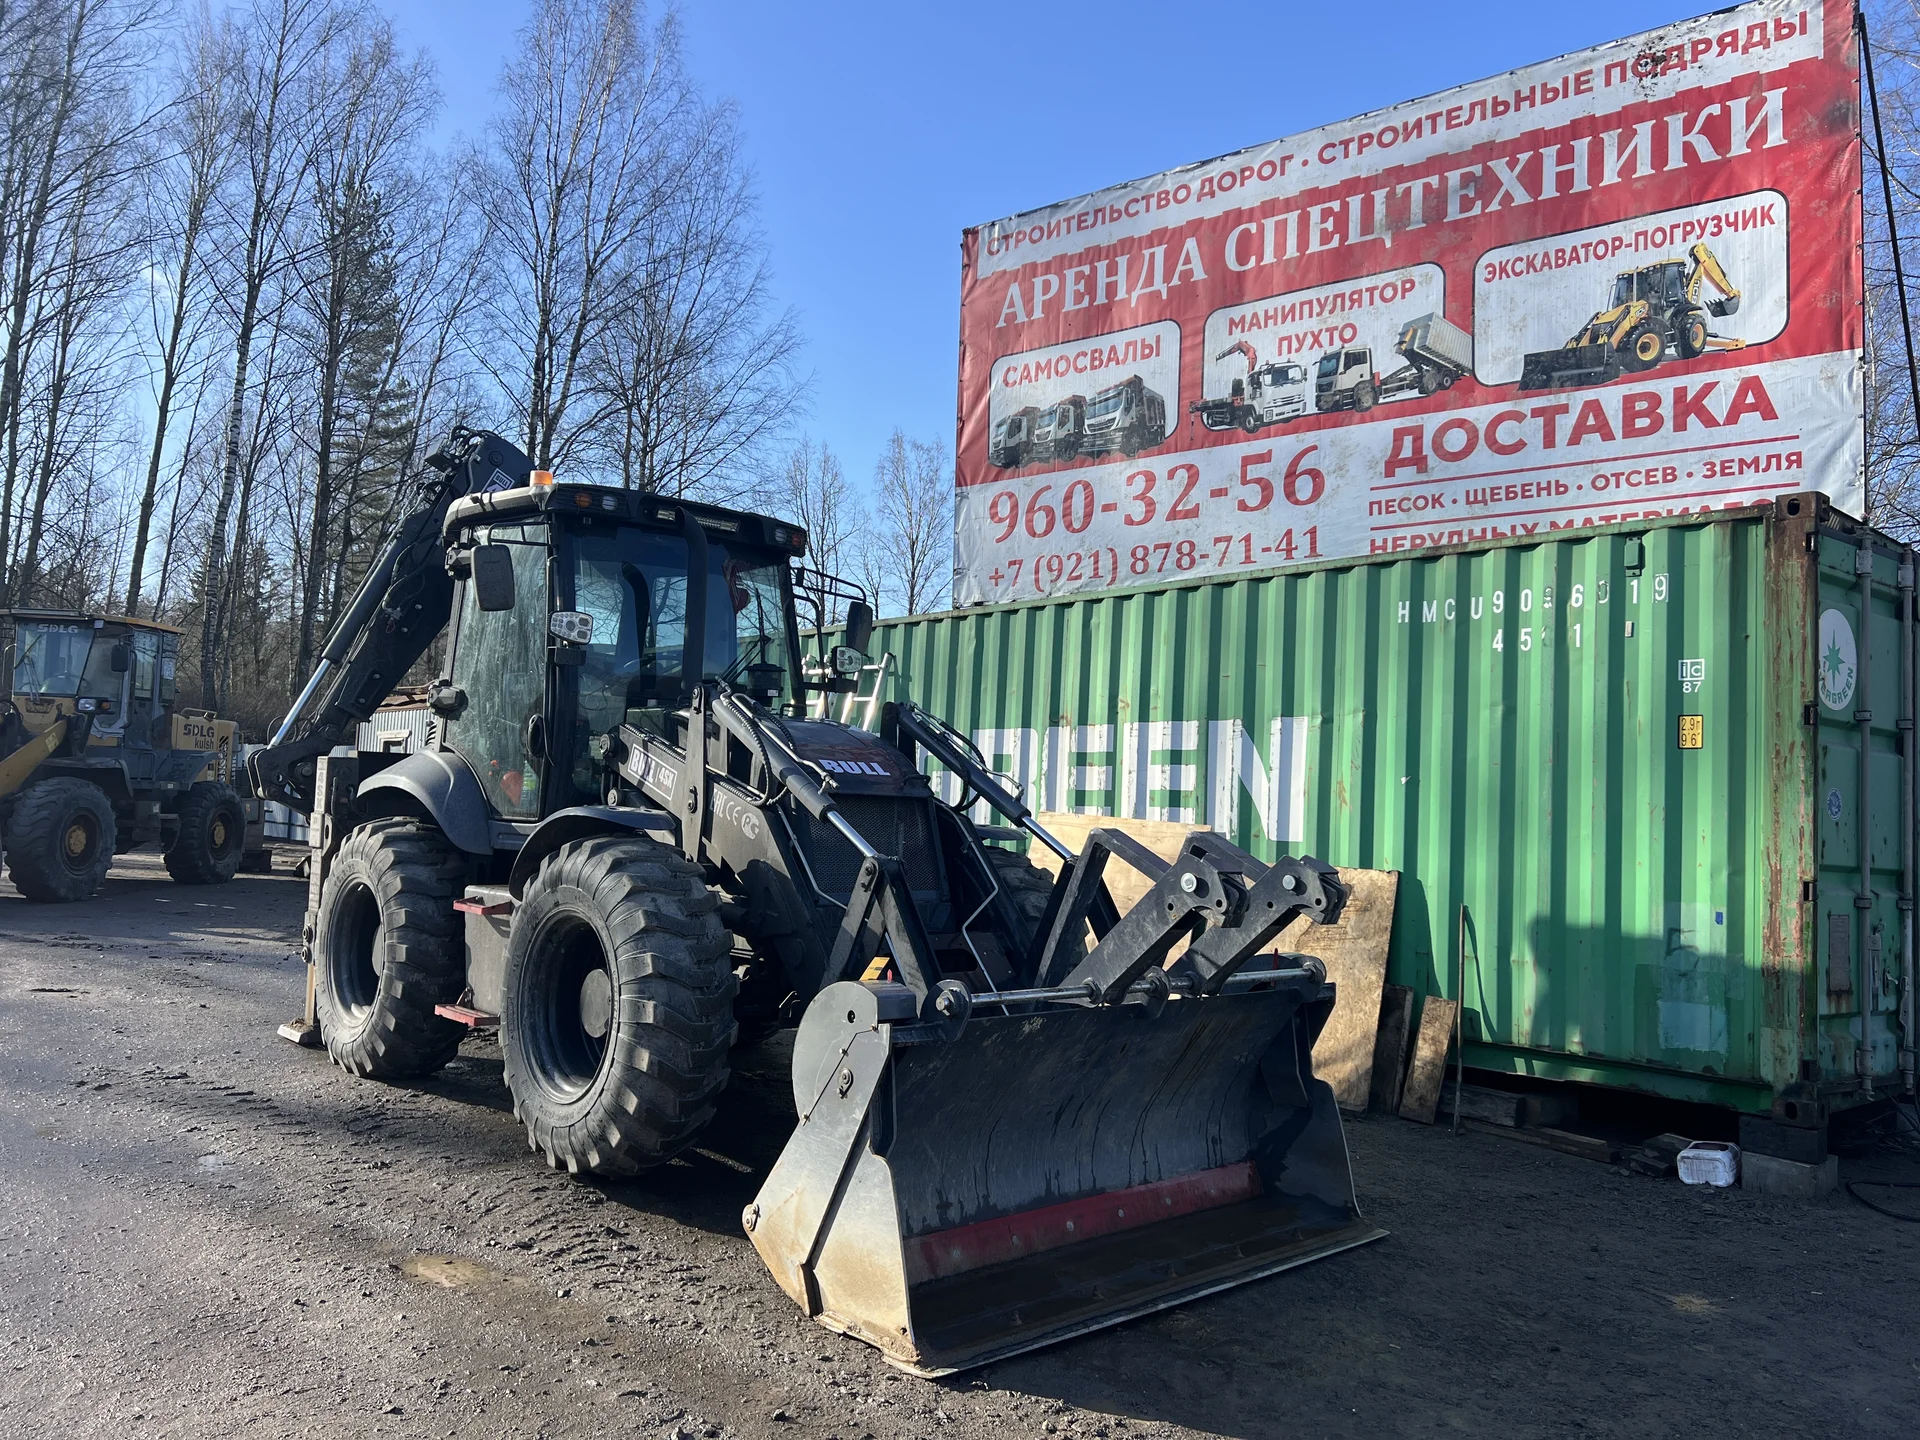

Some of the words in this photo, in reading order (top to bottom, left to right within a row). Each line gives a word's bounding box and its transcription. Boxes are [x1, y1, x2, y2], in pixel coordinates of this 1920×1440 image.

[986, 184, 1191, 255] СТРОИТЕЛЬСТВО
[1197, 154, 1294, 202] ДОРОГ
[1317, 69, 1593, 164] СТРОИТЕЛЬНЫЕ
[1604, 11, 1808, 88] ПОДРЯДЫ
[995, 237, 1207, 328] АРЕНДА
[1224, 87, 1788, 272] СПЕЦТЕХНИКИ
[1484, 203, 1775, 281] ЭКСКАВАТОР-ПОГРУЗЧИК
[1228, 278, 1416, 336] МАНИПУЛЯТОР
[1002, 335, 1161, 388] САМОСВАЛЫ
[1277, 322, 1358, 357] ПУХТО
[1384, 375, 1779, 478] ДОСТАВКА
[988, 444, 1326, 544] 960-32-56
[1368, 493, 1446, 516] ПЕСОК
[1465, 479, 1569, 505] ЩЕБЕНЬ
[1591, 466, 1678, 491] ОТСЕВ
[1702, 451, 1803, 479] ЗЕМЛЯ
[989, 558, 1023, 587] +7
[1033, 547, 1118, 592] (921)
[1129, 525, 1324, 575] 878-71-41
[37, 623, 79, 634] SDLG
[1682, 681, 1702, 693] 87
[1820, 662, 1854, 704] ERGREEN
[183, 723, 215, 738] SDLG
[630, 748, 656, 783] BULL
[818, 759, 891, 776] BULL
